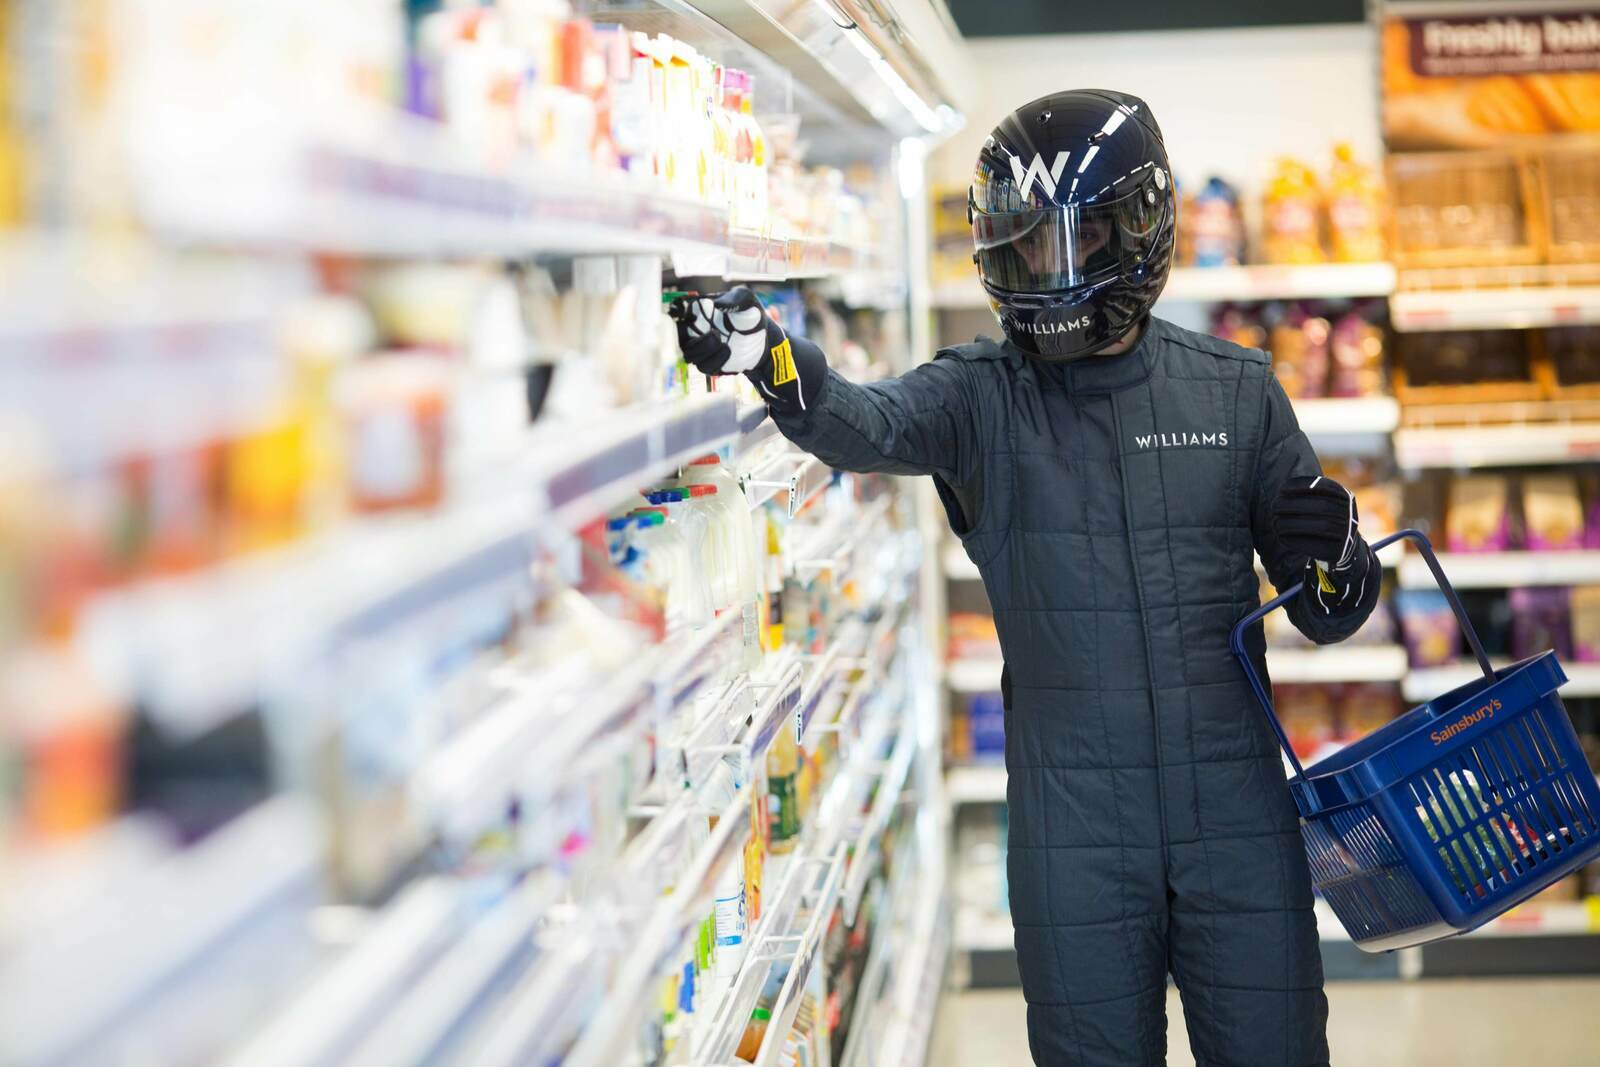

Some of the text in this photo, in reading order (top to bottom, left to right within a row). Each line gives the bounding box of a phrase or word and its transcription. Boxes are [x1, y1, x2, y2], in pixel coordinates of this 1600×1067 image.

[1014, 315, 1091, 335] WILLIAMS
[1135, 432, 1229, 449] WILLIAMS
[1430, 699, 1503, 746] Sainsbury's
